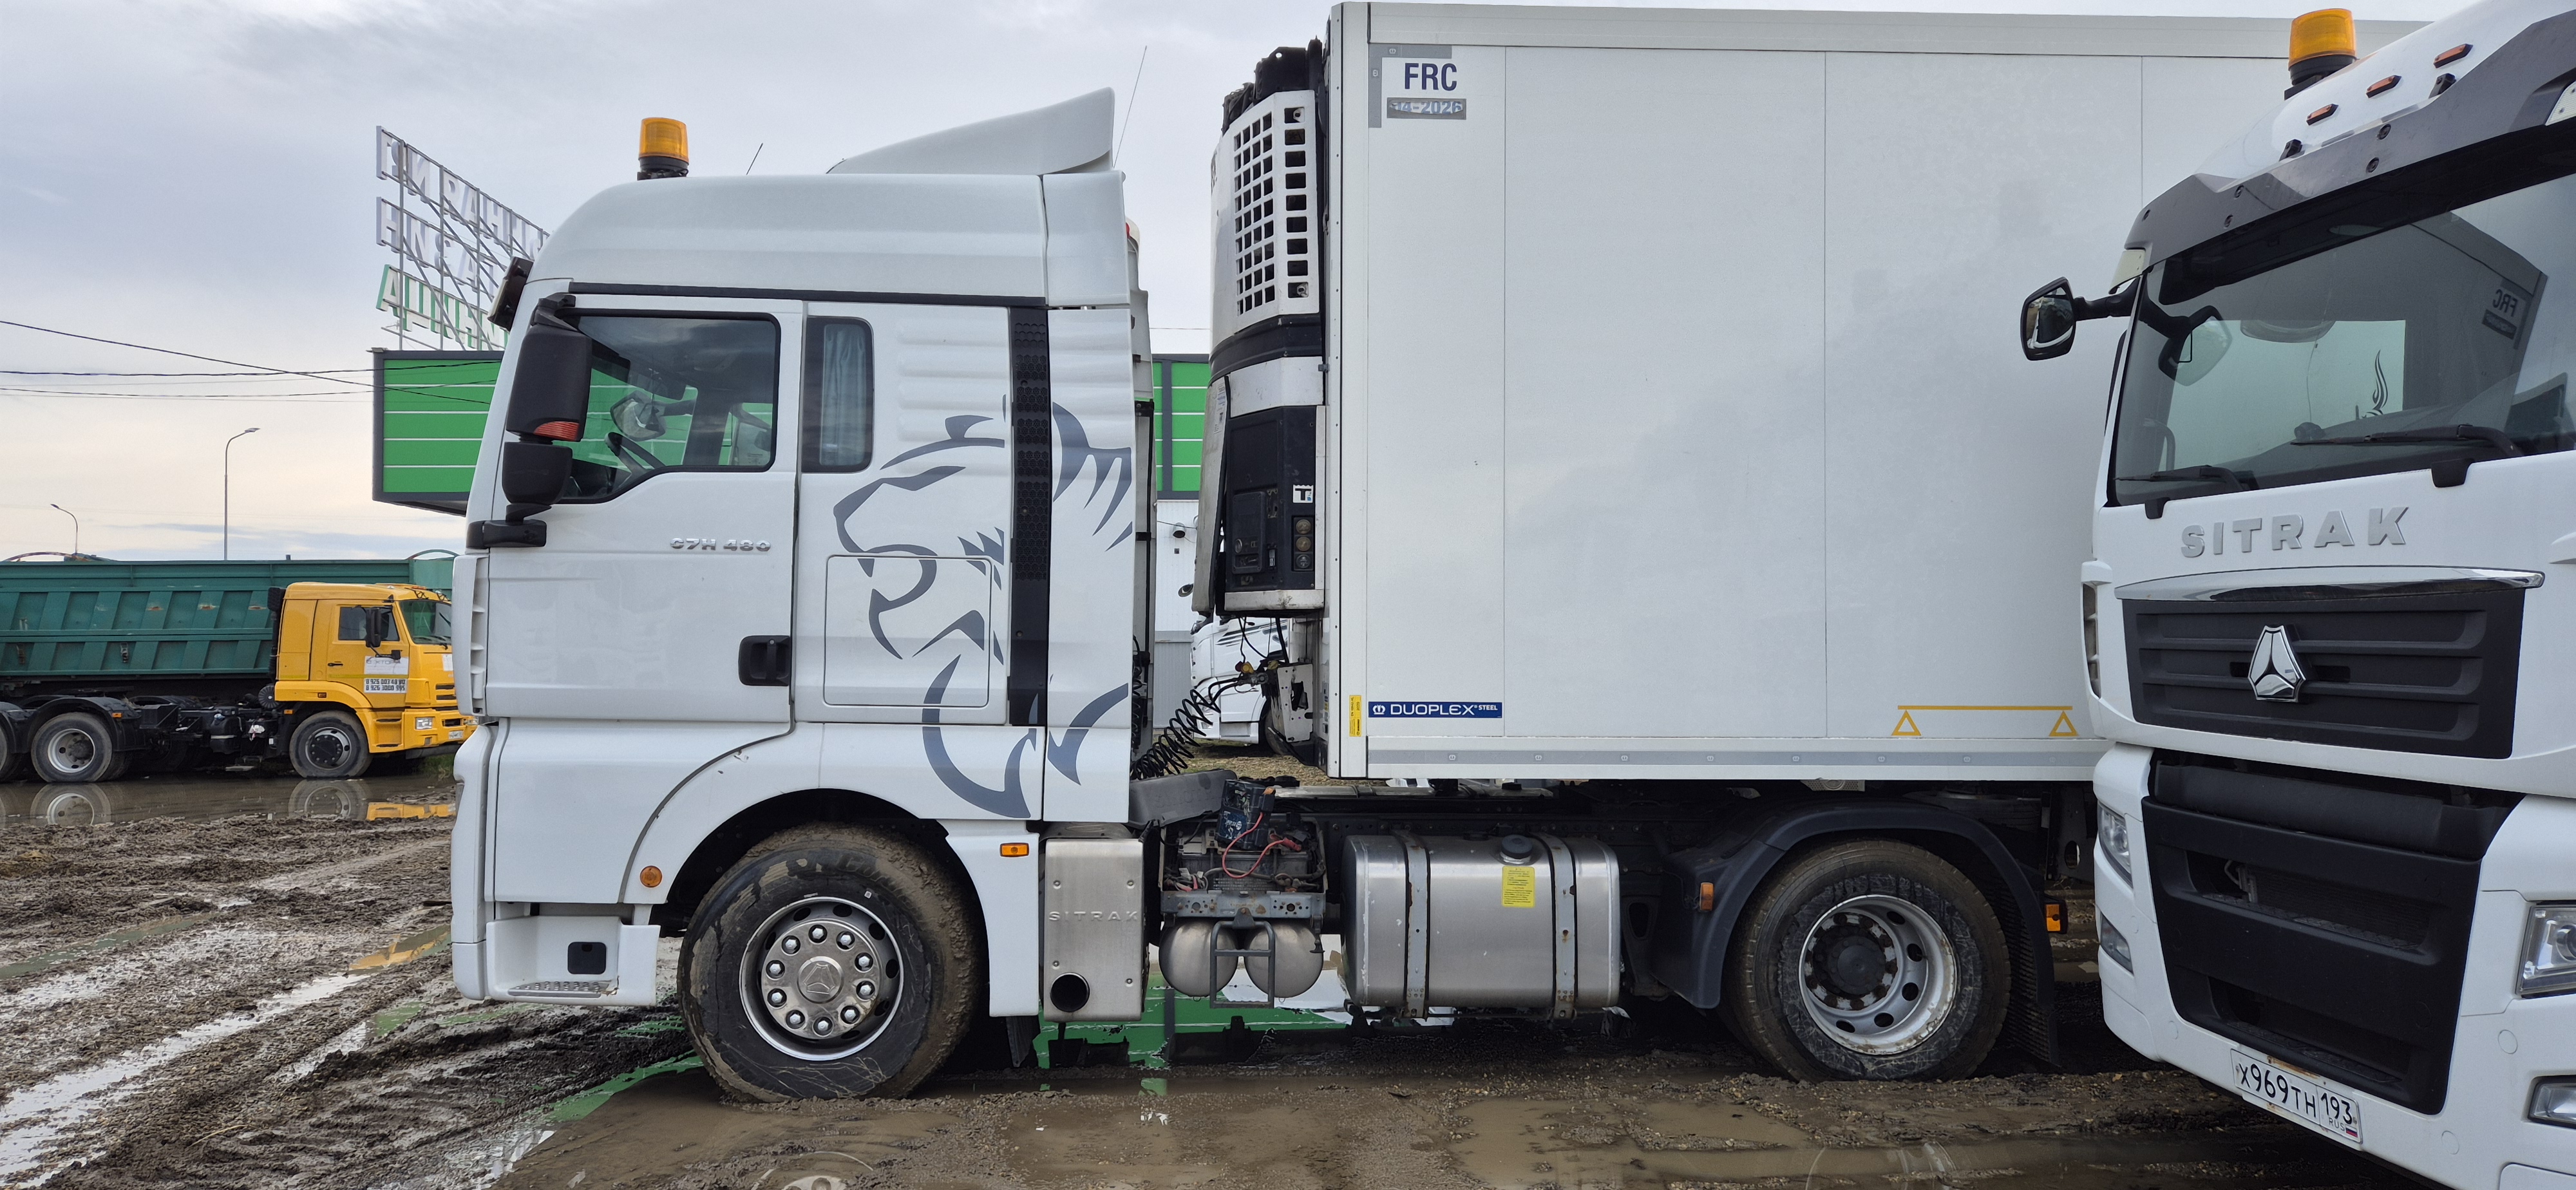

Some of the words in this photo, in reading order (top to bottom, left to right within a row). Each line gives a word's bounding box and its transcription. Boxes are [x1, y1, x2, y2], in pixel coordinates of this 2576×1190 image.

[1405, 62, 1457, 91] FRC
[2181, 506, 2409, 558] SITRAK
[670, 538, 717, 551] C7H
[723, 539, 772, 552] 480
[1048, 911, 1139, 921] SITRAK
[2321, 1092, 2353, 1125] 193
[2329, 1117, 2345, 1131] RUS
